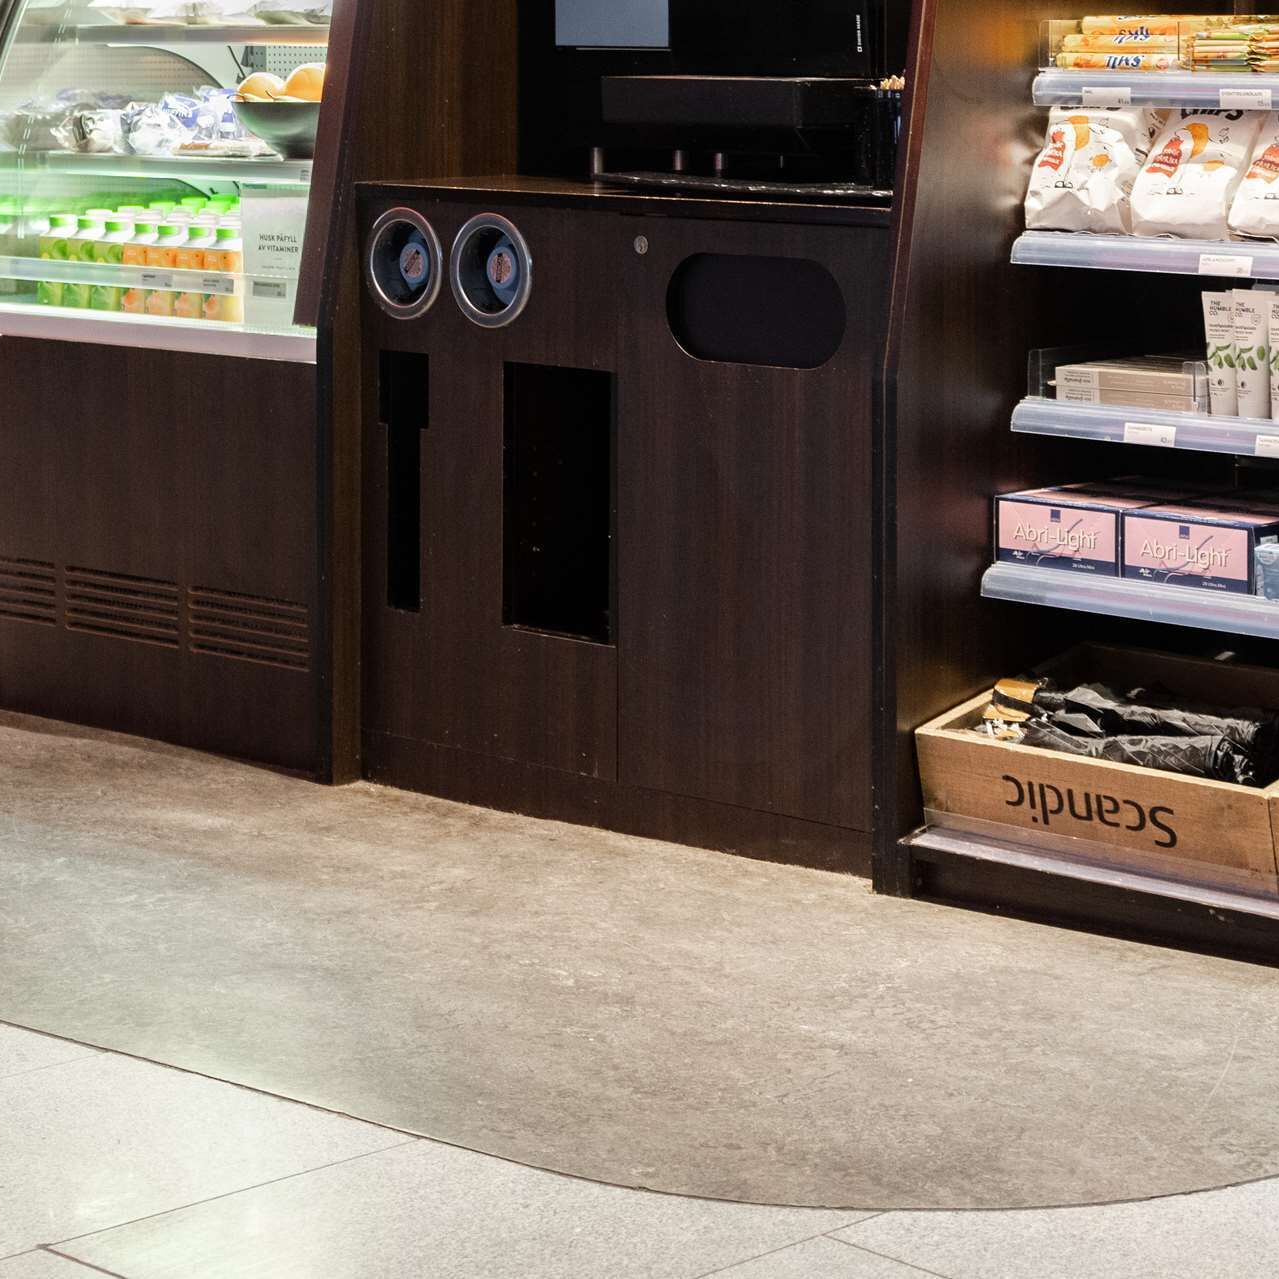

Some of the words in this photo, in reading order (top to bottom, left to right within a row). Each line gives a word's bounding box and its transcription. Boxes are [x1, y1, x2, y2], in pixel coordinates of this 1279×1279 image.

[259, 233, 275, 241] HUSK
[276, 233, 297, 243] PÅFYLL
[267, 245, 299, 253] VITAMINER
[1013, 523, 1099, 550] Abri-Light
[1141, 540, 1232, 568] Abri-Light
[1002, 775, 1177, 849] Scandic
